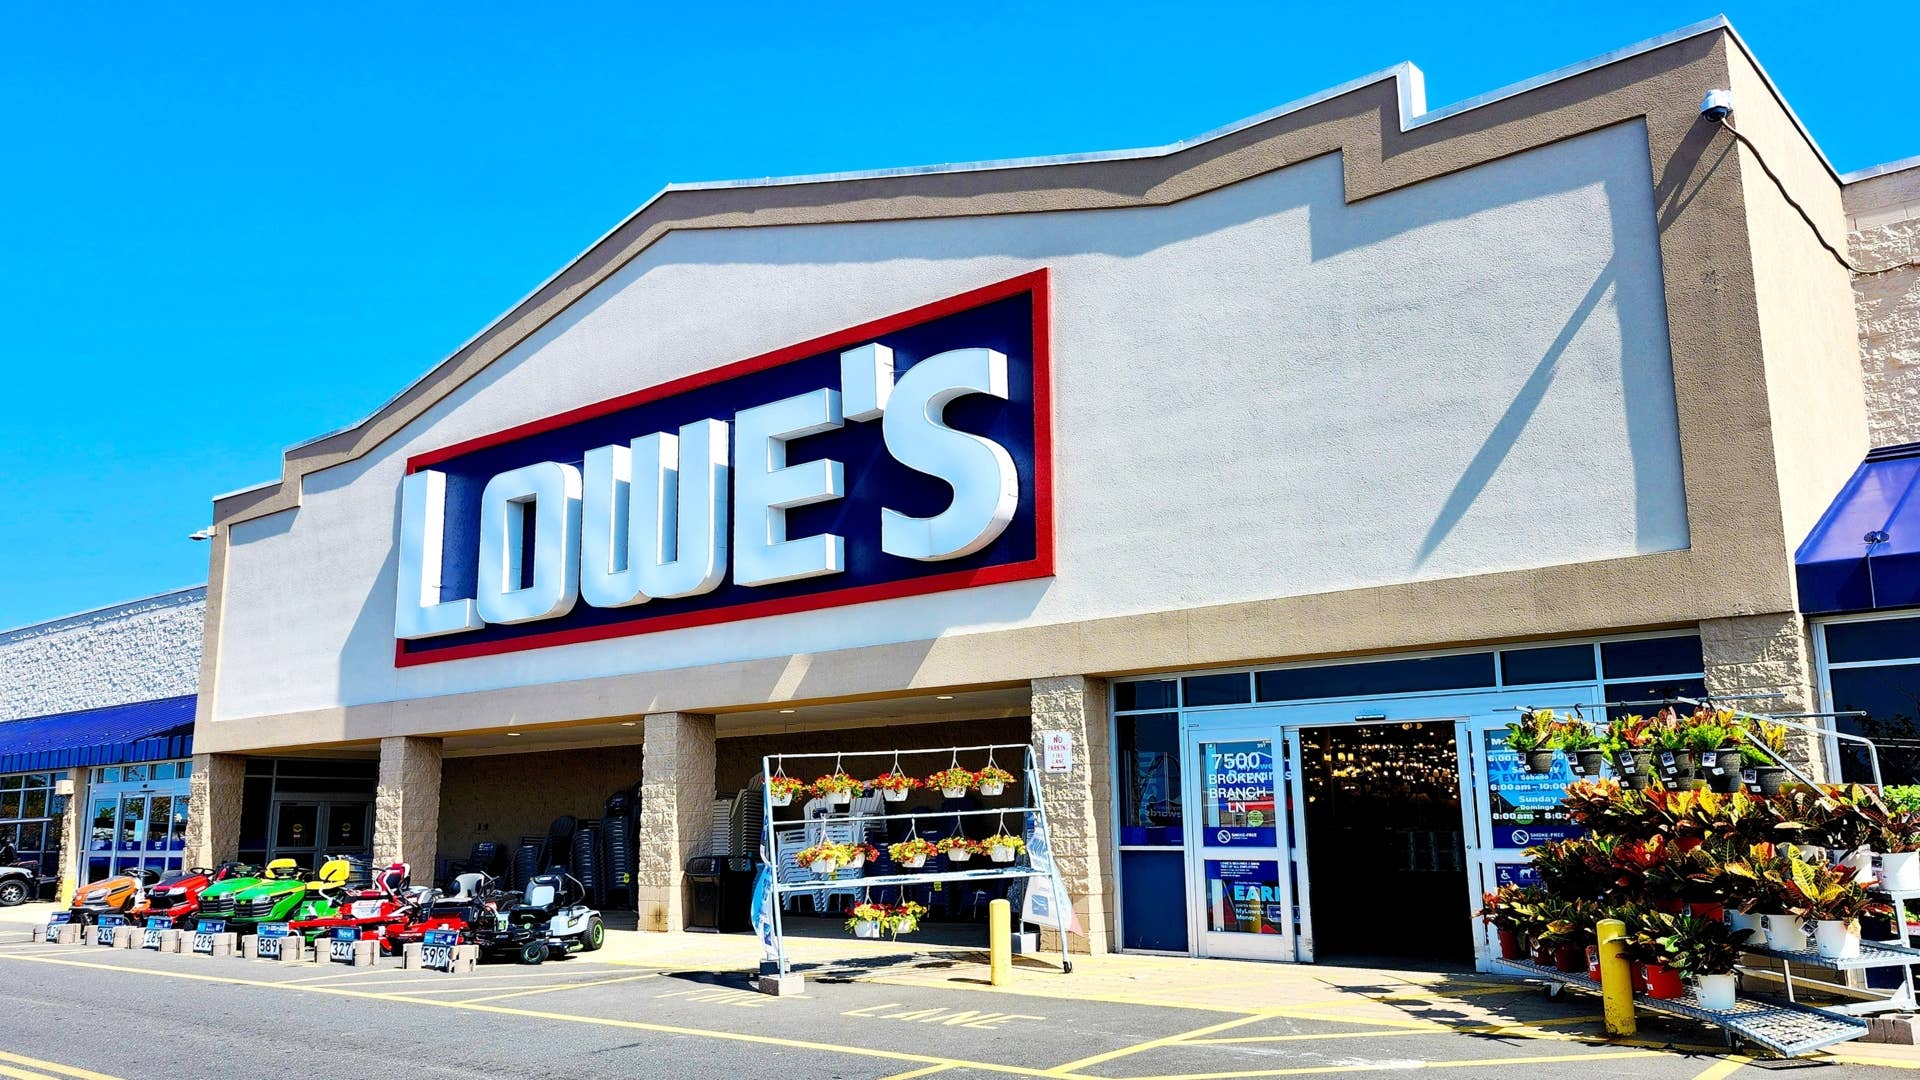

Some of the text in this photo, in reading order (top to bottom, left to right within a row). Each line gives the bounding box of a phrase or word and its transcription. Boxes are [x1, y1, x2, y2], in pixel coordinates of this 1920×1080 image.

[394, 342, 1019, 640] LOWE'S
[1053, 735, 1063, 744] NO
[1211, 752, 1260, 770] 7500
[1208, 772, 1265, 784] BROKEN
[1209, 786, 1266, 799] BRANCH
[1519, 795, 1557, 804] Sunday
[1228, 801, 1246, 812] LN
[1492, 812, 1534, 820] 8:00am
[196, 935, 212, 948] 289
[260, 939, 278, 952] 589
[332, 942, 351, 956] 327
[839, 1003, 1047, 1030] LANE
